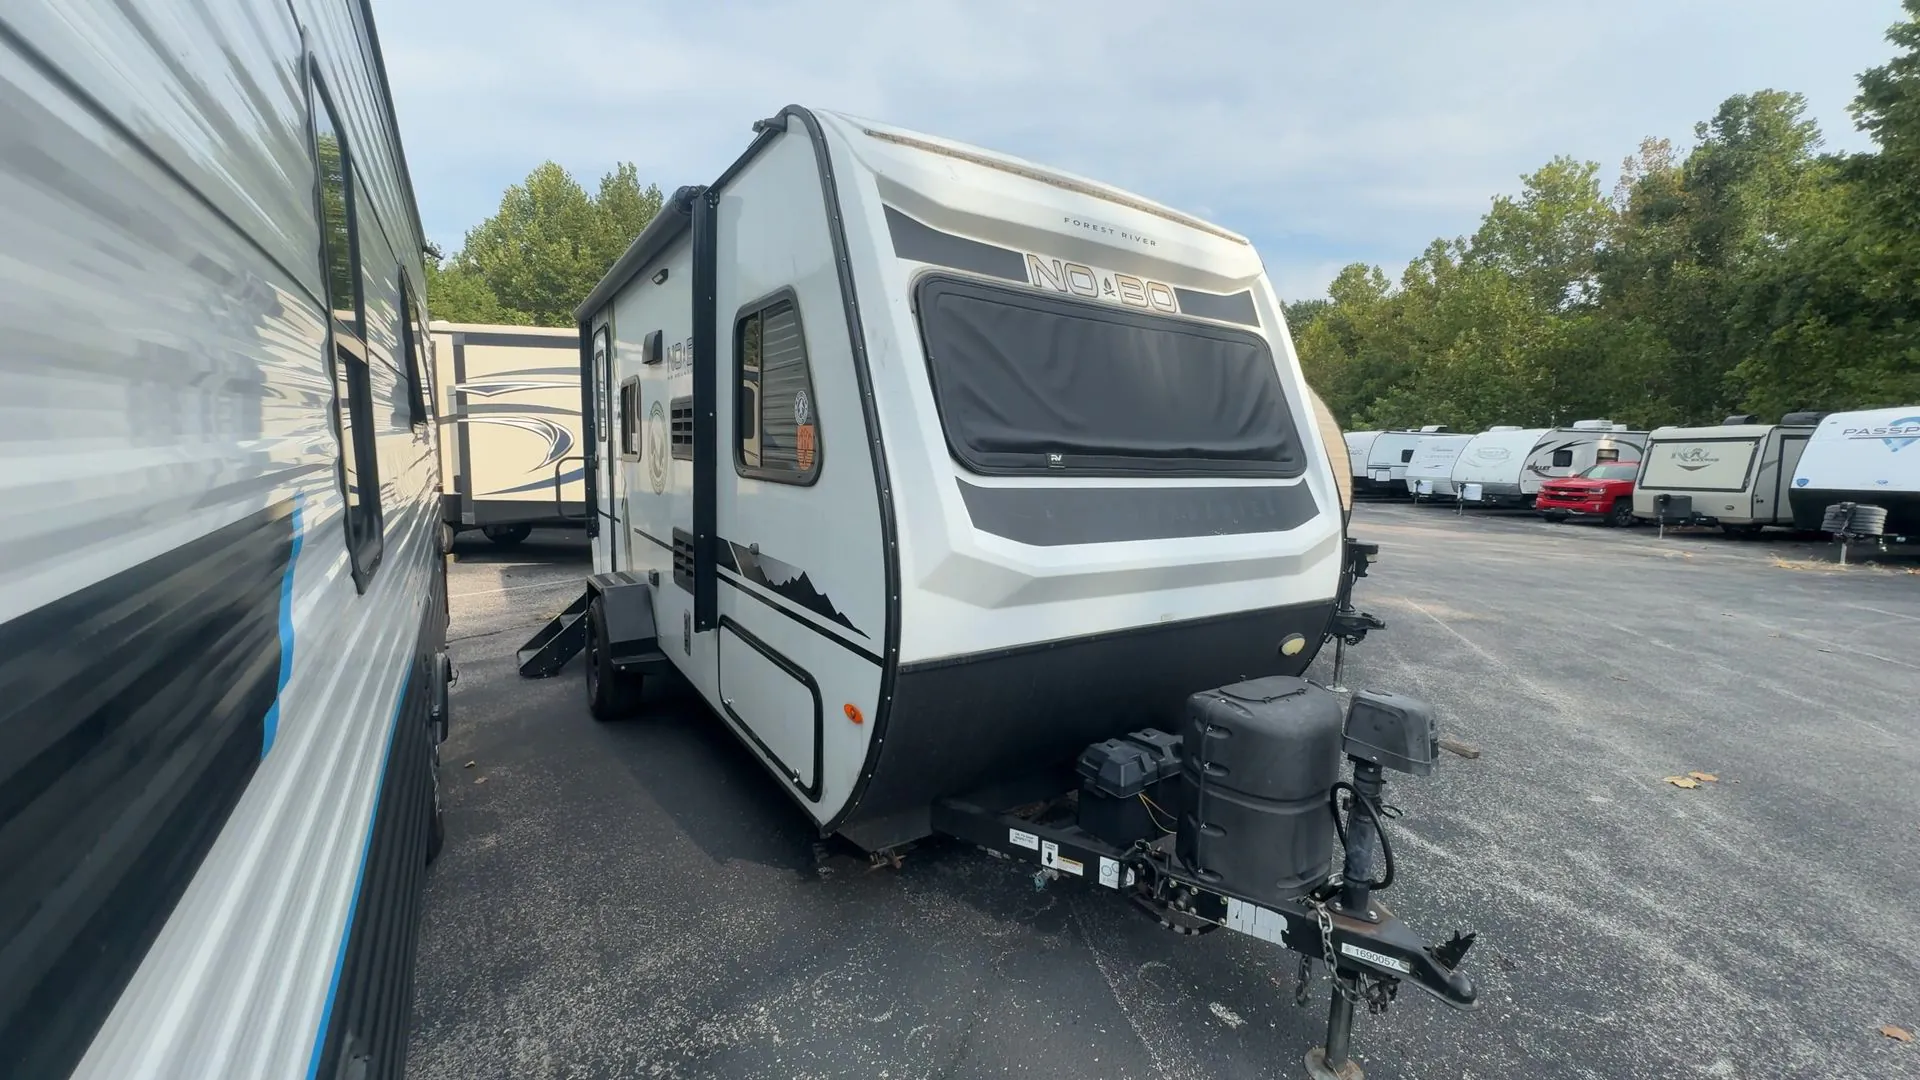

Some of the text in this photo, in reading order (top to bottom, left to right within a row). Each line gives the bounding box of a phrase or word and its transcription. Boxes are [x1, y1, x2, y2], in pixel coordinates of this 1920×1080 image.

[1064, 216, 1157, 247] FOREST RIVER
[1355, 948, 1397, 967] 1690057
